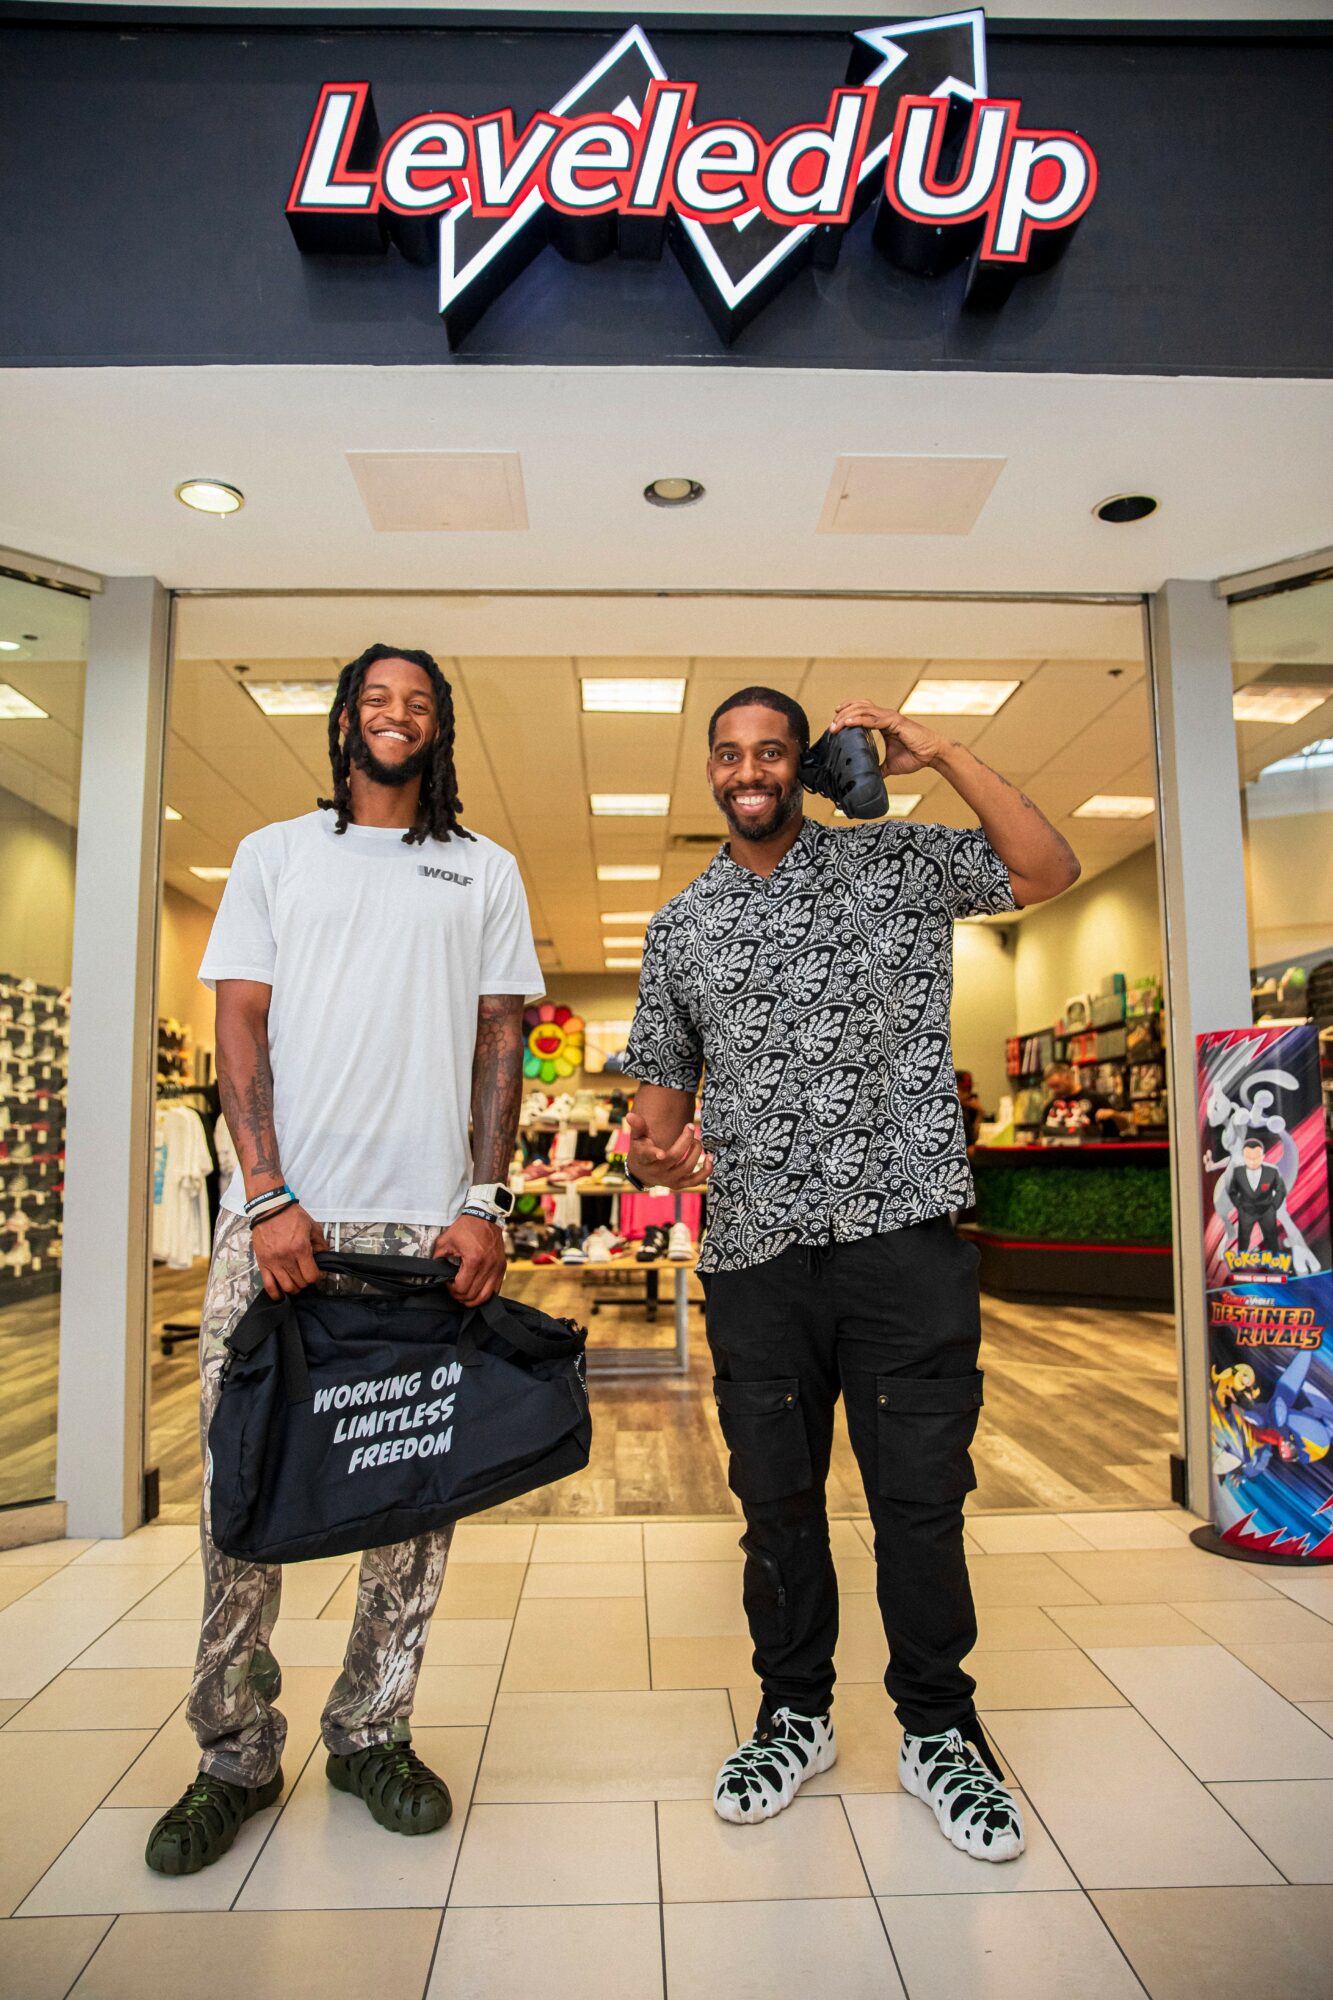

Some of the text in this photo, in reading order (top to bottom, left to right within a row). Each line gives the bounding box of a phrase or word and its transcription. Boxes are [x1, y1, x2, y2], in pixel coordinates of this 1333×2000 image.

[287, 82, 1097, 261] Leveled Up
[421, 865, 474, 887] WOLF
[1212, 1303, 1315, 1327] DESTINED
[1237, 1325, 1324, 1348] RIVALS
[313, 1361, 463, 1414] WORKING ON
[333, 1392, 457, 1444] LIMITLESS
[347, 1425, 453, 1475] FREEDOM
